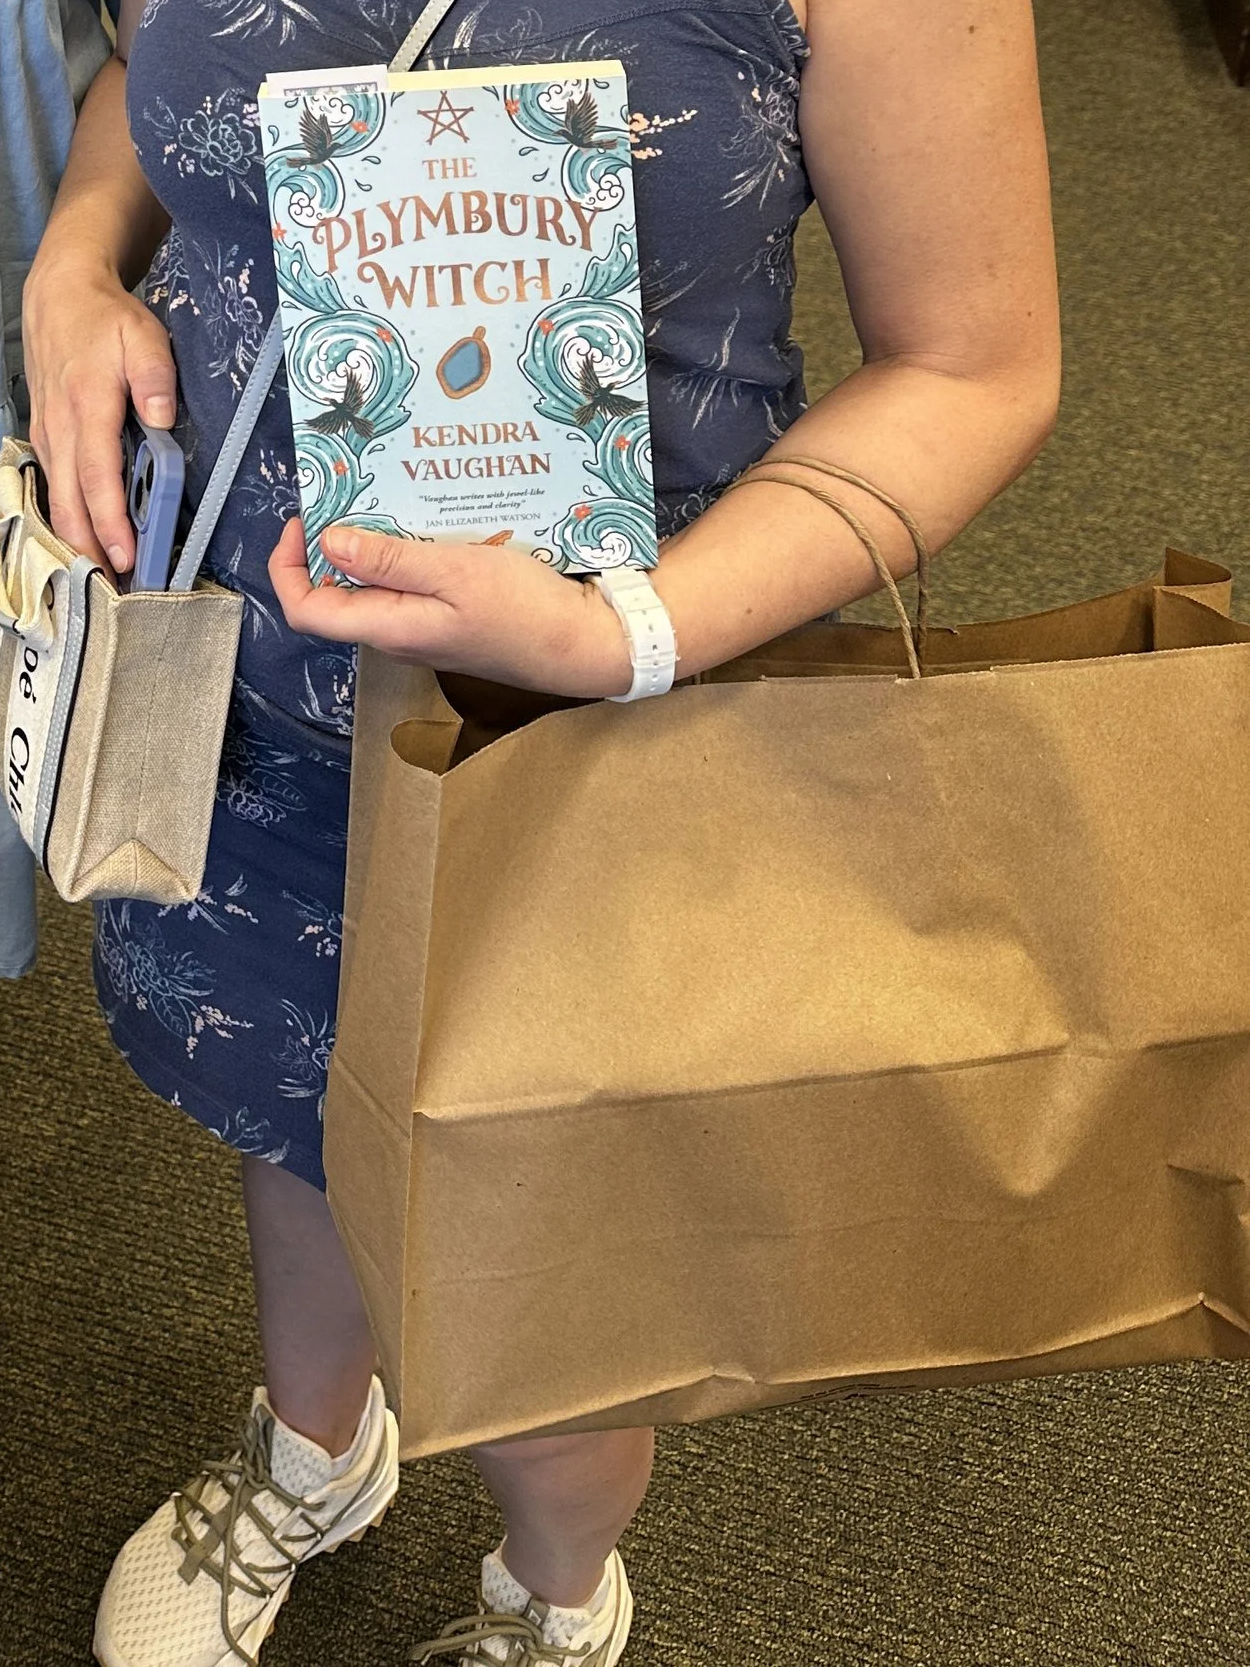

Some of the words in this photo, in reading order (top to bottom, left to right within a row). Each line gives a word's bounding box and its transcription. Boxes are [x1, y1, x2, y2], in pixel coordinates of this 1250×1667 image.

[422, 157, 477, 180] THE
[312, 190, 601, 273] PLYMBURY
[357, 258, 553, 310] WITCH
[412, 421, 541, 448] KENDRA
[400, 452, 551, 482] VAUGHAN
[460, 492, 485, 502] writes
[486, 489, 505, 500] with
[505, 487, 546, 500] jewel-like
[439, 502, 476, 514] precision
[477, 501, 493, 511] and
[425, 519, 444, 529] JAN
[445, 515, 498, 527] ELIZABETH
[499, 512, 542, 523] WATSON
